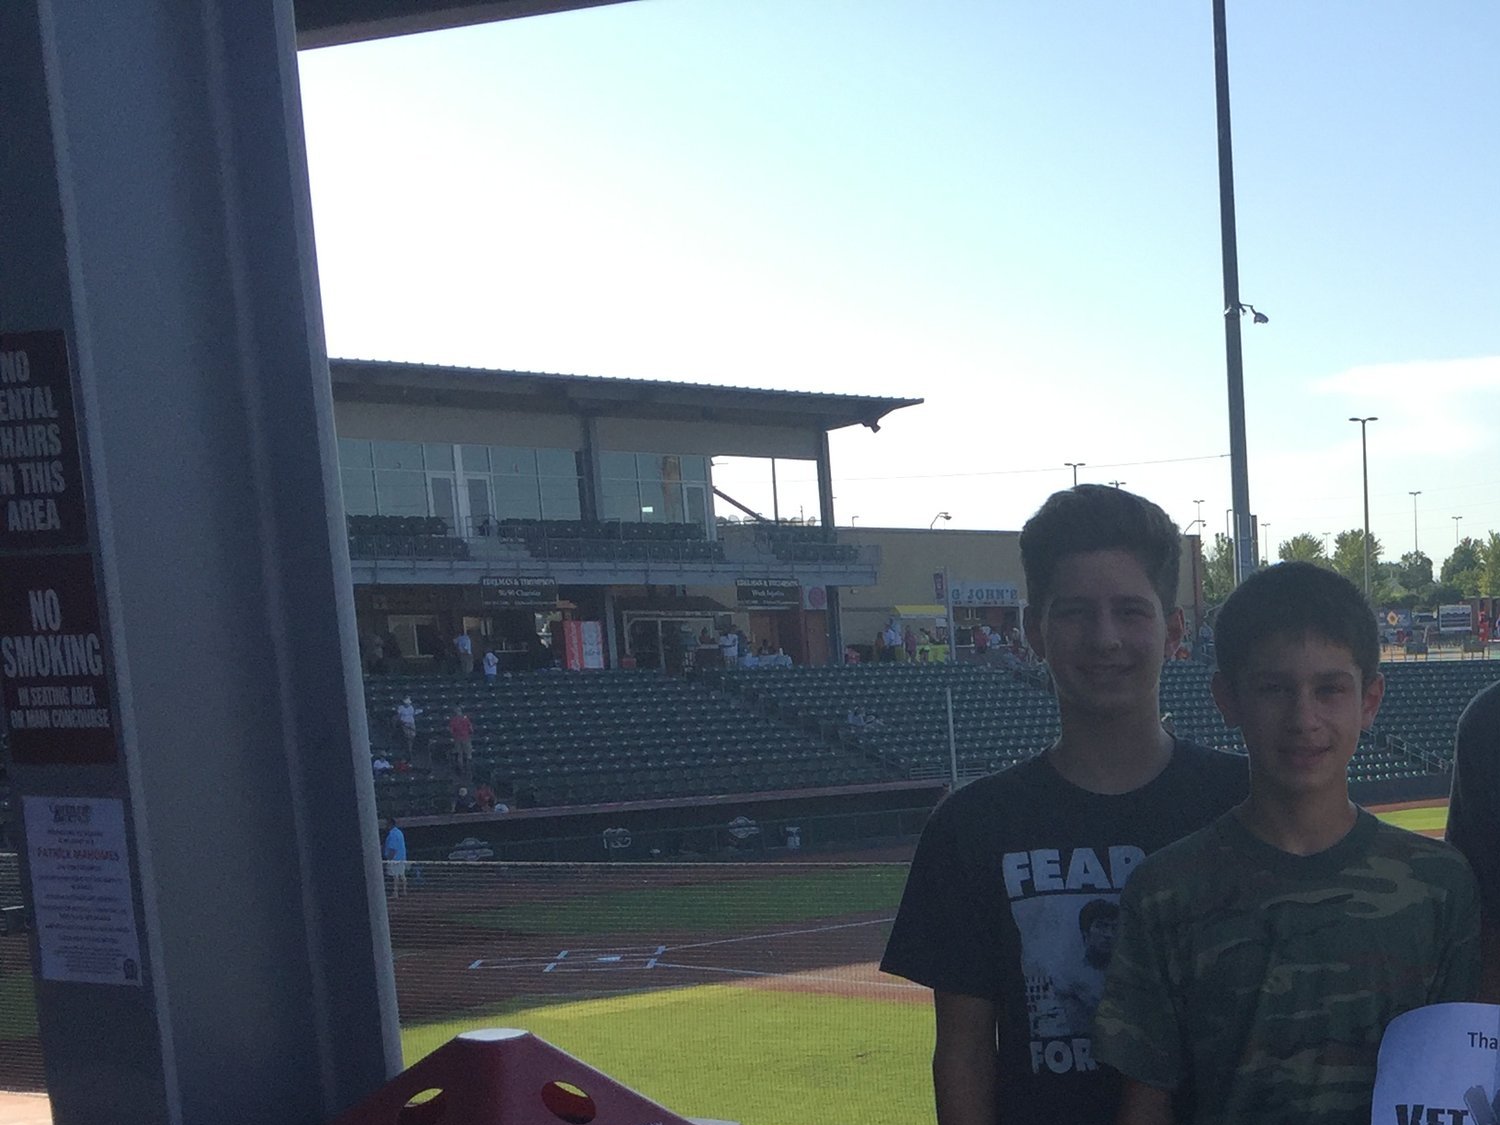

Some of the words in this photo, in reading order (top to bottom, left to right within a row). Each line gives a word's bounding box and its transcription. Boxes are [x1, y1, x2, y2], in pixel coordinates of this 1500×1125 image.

[0, 351, 30, 382] NO
[0, 385, 58, 421] ENTAL
[0, 424, 62, 458] HAIRS
[19, 460, 66, 495] THIS
[8, 498, 61, 532] AREA
[28, 588, 61, 632] NO
[1, 632, 103, 678] SMOKING
